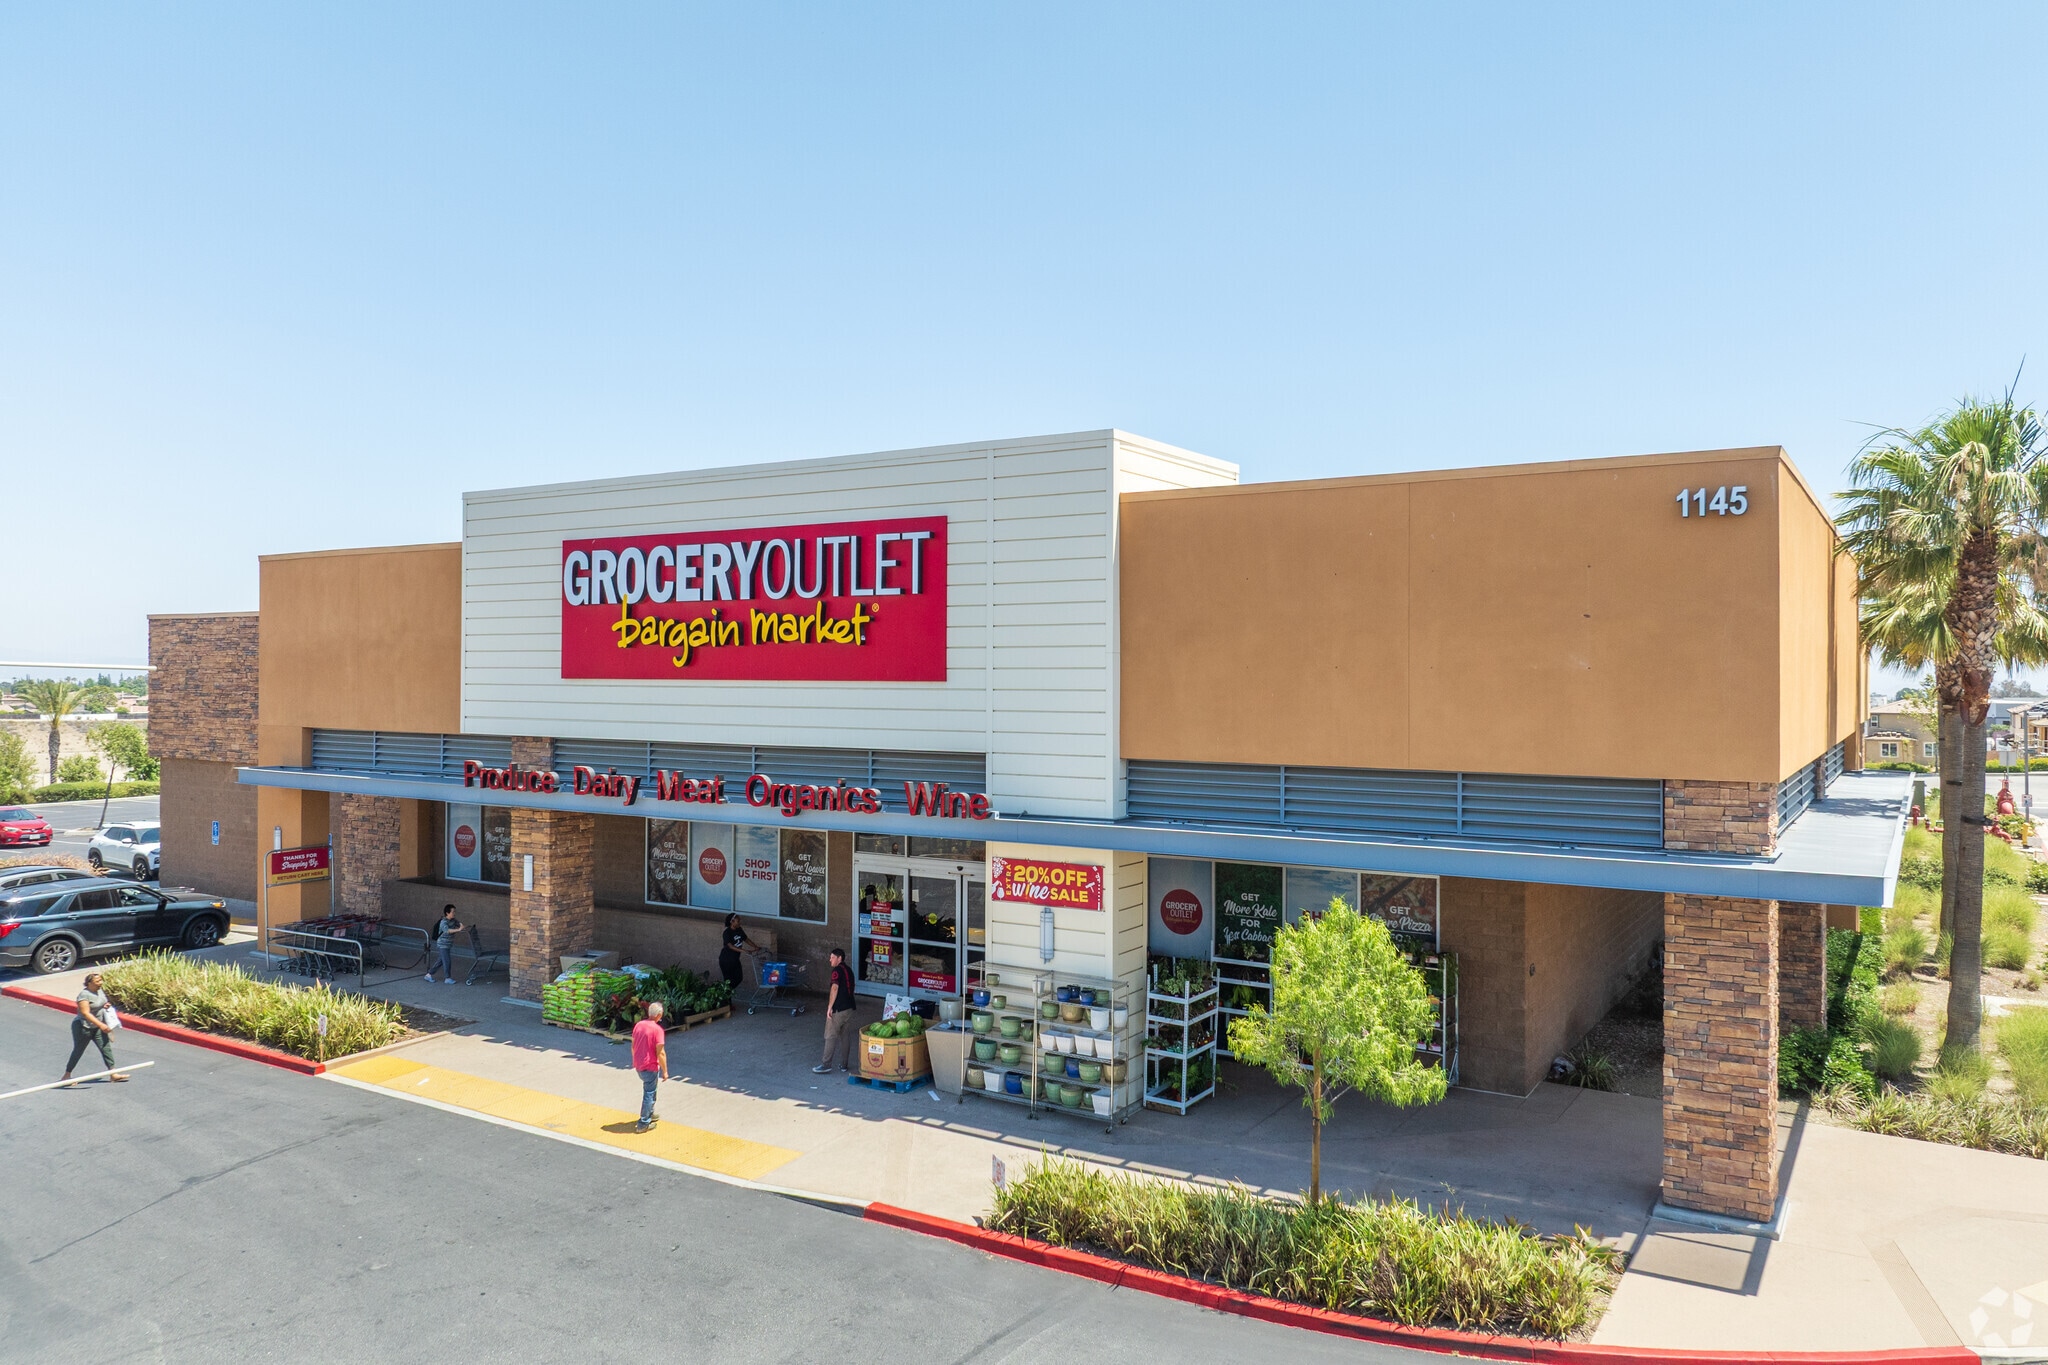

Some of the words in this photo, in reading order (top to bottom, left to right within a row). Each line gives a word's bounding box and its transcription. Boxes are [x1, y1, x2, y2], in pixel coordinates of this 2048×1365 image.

[1676, 486, 1748, 517] 1145
[611, 594, 744, 668] bargain
[463, 759, 560, 794] Produce
[573, 765, 641, 806] Dairy
[657, 769, 727, 805] Meat
[745, 773, 882, 817] Organics
[904, 781, 994, 820] Wine
[652, 847, 668, 860] More
[670, 849, 687, 861] Pizza
[798, 853, 812, 861] GET
[282, 861, 308, 870] Shopping
[702, 858, 724, 866] GROCERY
[745, 858, 771, 869] SHOP
[784, 859, 804, 873] More
[804, 861, 826, 875] Loaves
[666, 869, 684, 883] Dough
[738, 869, 751, 878] US
[752, 870, 777, 881] FIRST
[797, 875, 812, 883] FOR
[801, 884, 822, 895] Bread
[1050, 887, 1089, 903] SALE
[1241, 893, 1260, 902] GET
[1165, 901, 1198, 912] GROCERY
[1223, 900, 1251, 915] More
[1252, 903, 1278, 919] Kale
[1389, 905, 1411, 915] GET
[1170, 909, 1193, 919] OUTLET
[1240, 919, 1260, 928] FOR
[1399, 916, 1433, 932] Pizza
[874, 944, 890, 954] EBT
